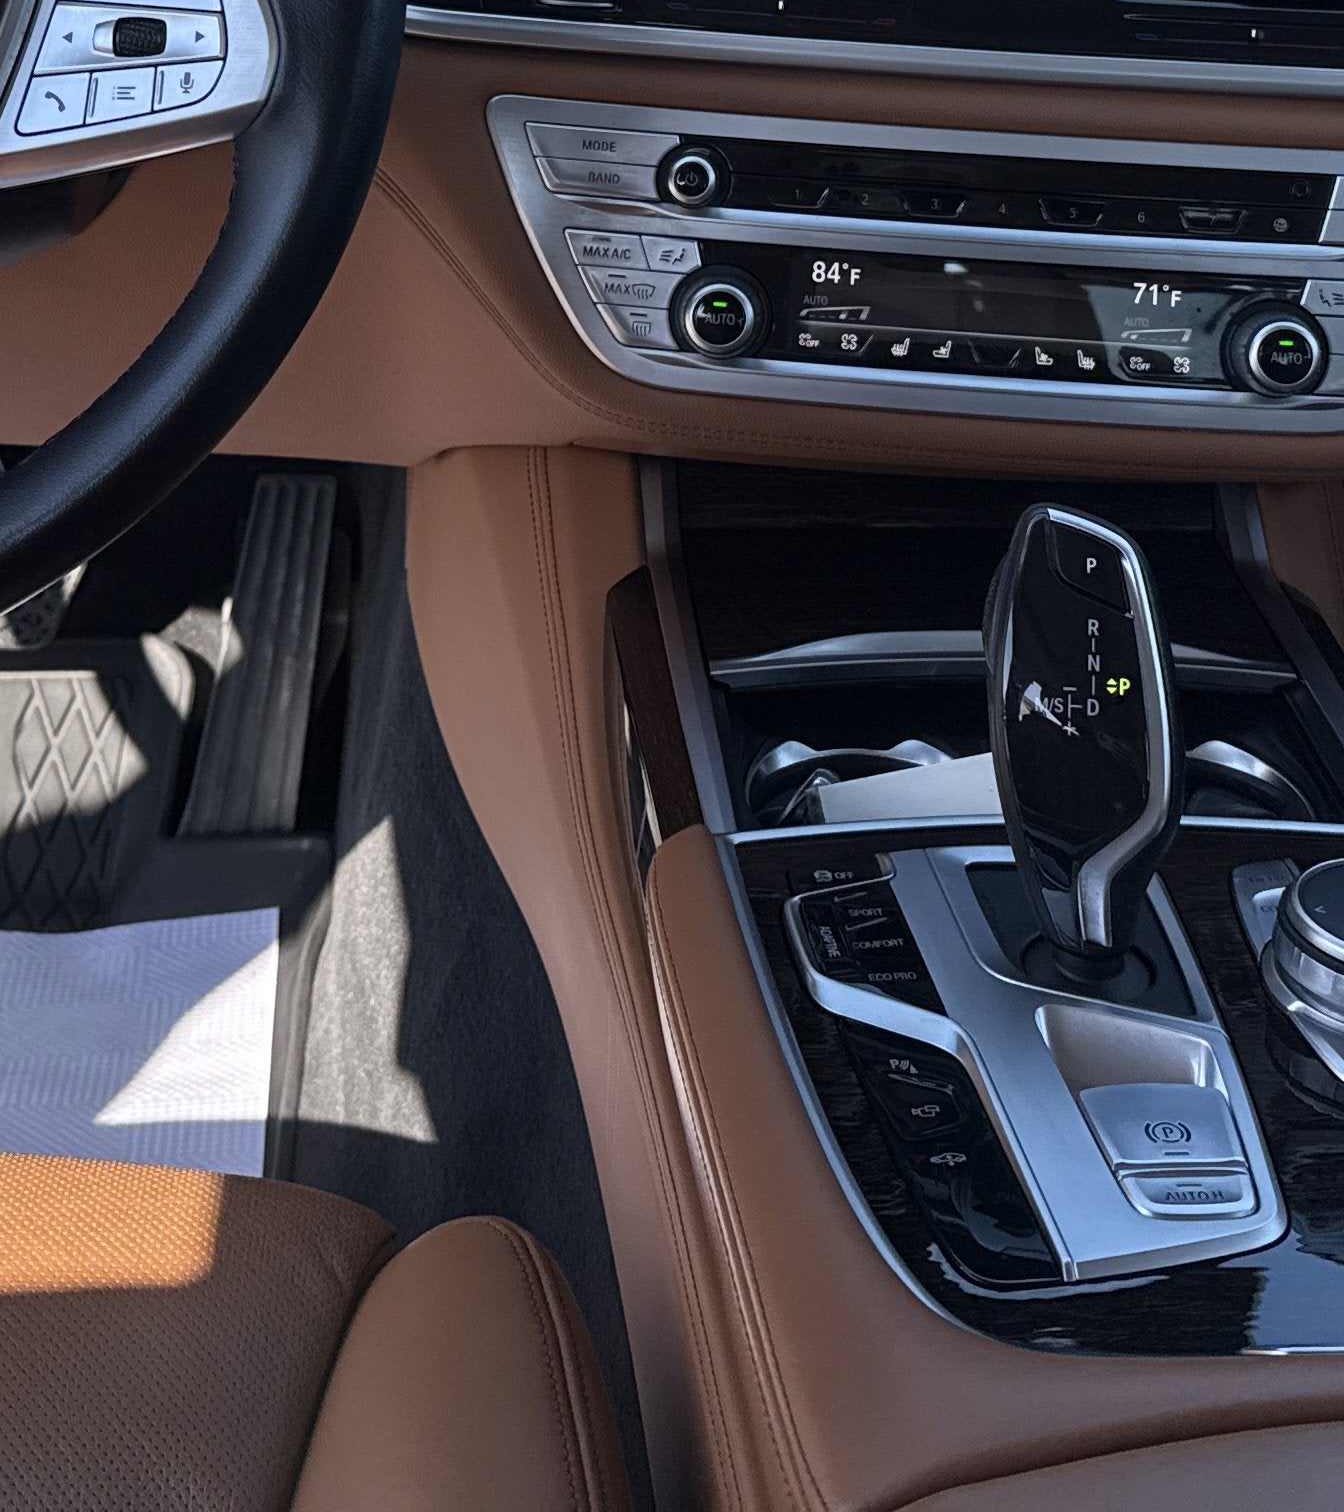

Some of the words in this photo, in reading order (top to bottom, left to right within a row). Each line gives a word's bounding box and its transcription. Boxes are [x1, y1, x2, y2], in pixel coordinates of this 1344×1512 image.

[581, 139, 617, 153] MODE
[587, 171, 621, 184] BAND
[1137, 211, 1146, 223] 6
[582, 245, 610, 258] MAX
[610, 247, 631, 260] A/C
[605, 282, 631, 295] MAX
[802, 294, 828, 306] AUTO
[705, 313, 736, 326] AUTO
[1124, 317, 1149, 328] AUTO
[1270, 351, 1302, 365] AUTO
[1086, 557, 1097, 575] P
[1087, 619, 1100, 637] R
[1087, 654, 1101, 672] N
[1119, 677, 1131, 696] P
[1087, 698, 1100, 717] D
[834, 871, 855, 880] OFF
[848, 908, 884, 918] SPORT
[851, 938, 905, 950] COMFORT
[867, 972, 893, 982] ECO
[894, 971, 918, 981] PRO
[1165, 1190, 1210, 1202] AUTO
[1211, 1190, 1225, 1200] H
